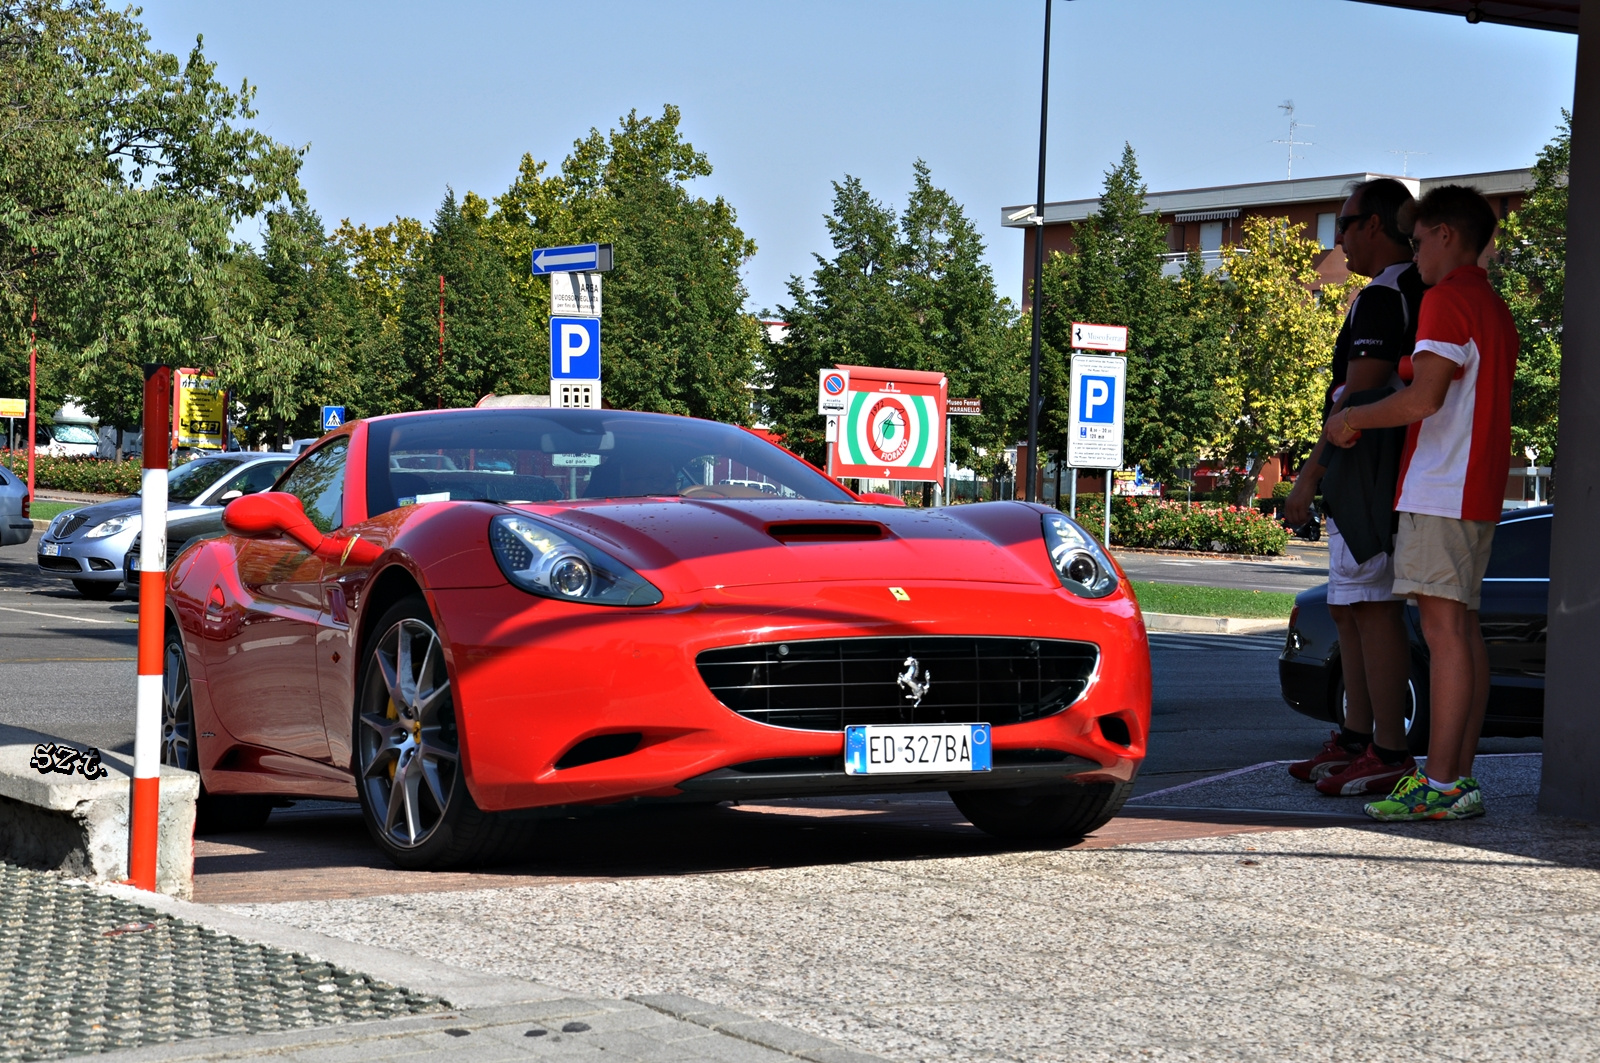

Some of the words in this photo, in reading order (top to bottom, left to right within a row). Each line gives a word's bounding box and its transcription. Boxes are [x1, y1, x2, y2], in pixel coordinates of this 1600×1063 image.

[554, 294, 598, 302] VIDEOSORVEGLIATA
[581, 284, 598, 292] AREA
[561, 324, 590, 373] P
[870, 400, 884, 417] 1972
[1085, 379, 1109, 418] P
[881, 438, 908, 461] FIORANO
[869, 735, 895, 764] ED
[903, 735, 970, 763] 327BA
